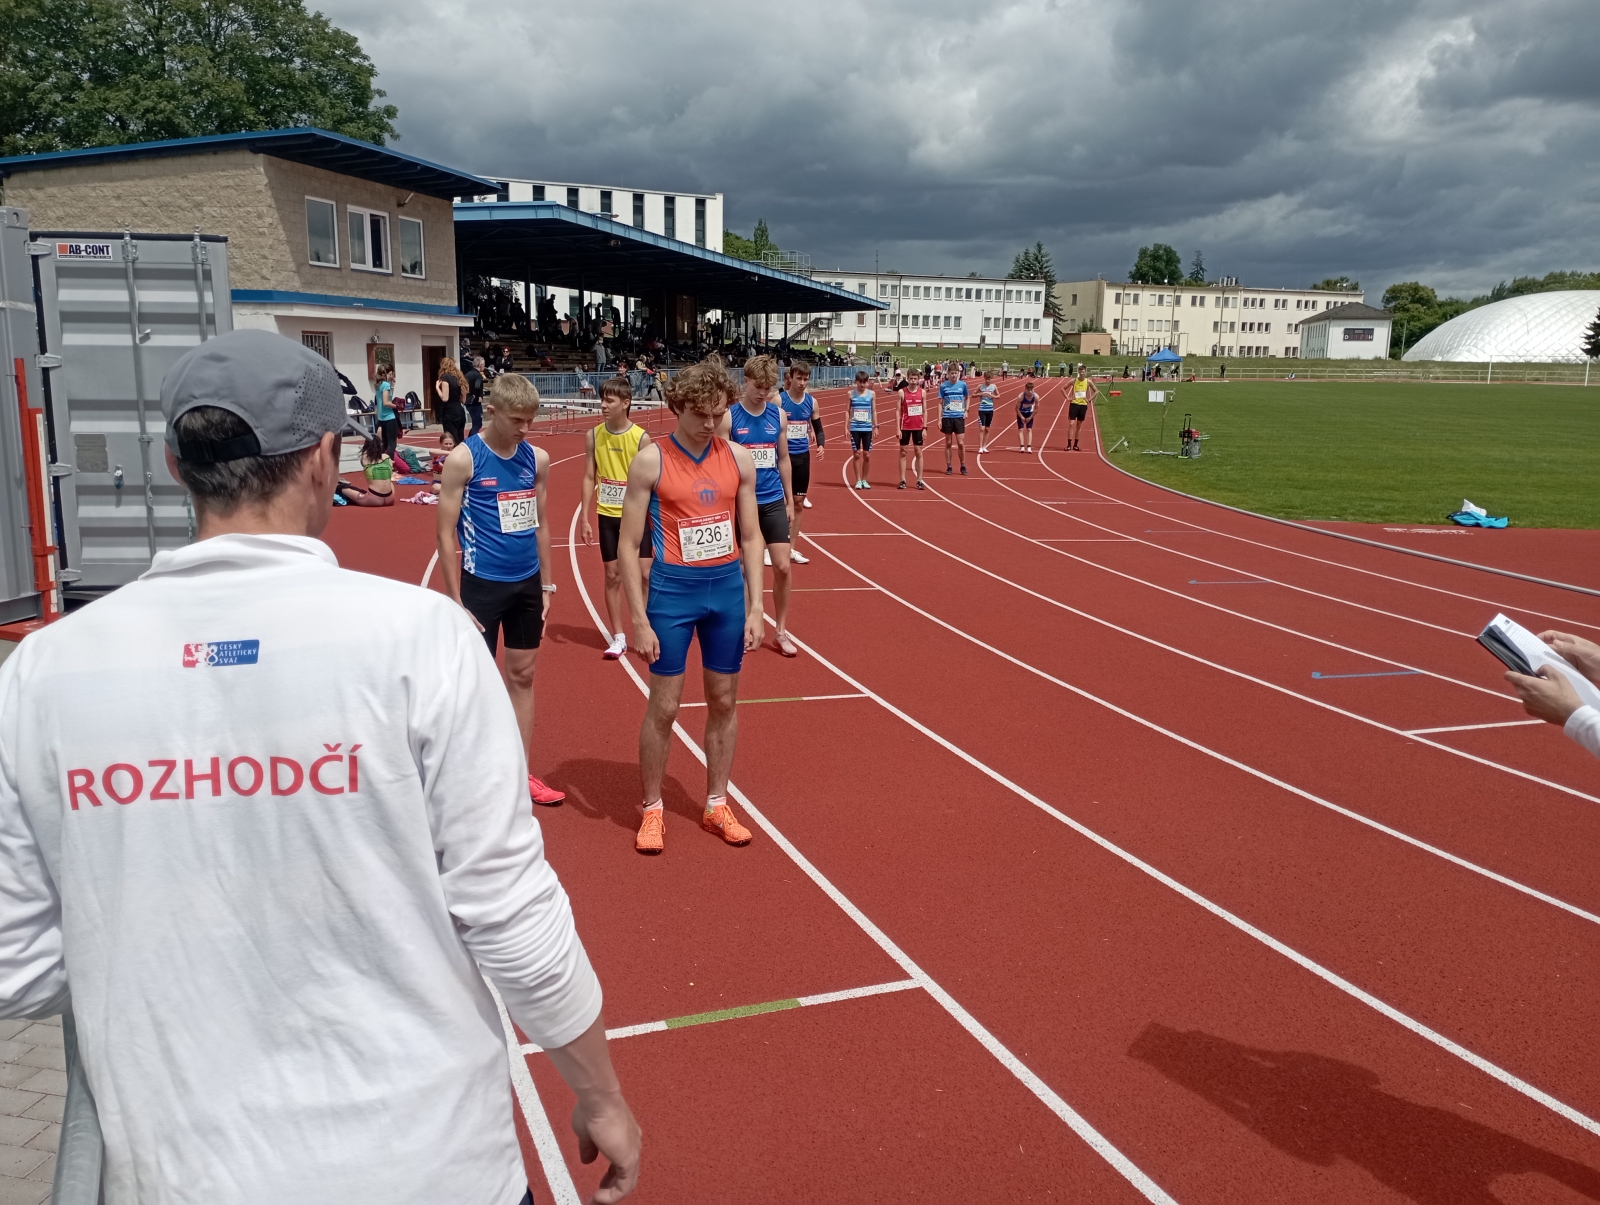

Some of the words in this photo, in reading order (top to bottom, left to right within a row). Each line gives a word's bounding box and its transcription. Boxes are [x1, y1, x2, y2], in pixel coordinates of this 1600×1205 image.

[69, 244, 110, 255] AB-CONT
[791, 425, 803, 433] 254
[751, 450, 768, 461] 308
[606, 485, 624, 498] 237
[511, 500, 531, 518] 257
[695, 525, 722, 546] 236
[219, 642, 242, 650] ČESKÝ
[219, 648, 257, 657] ATLETICKÝ
[67, 743, 363, 811] ROZHODČÍ
